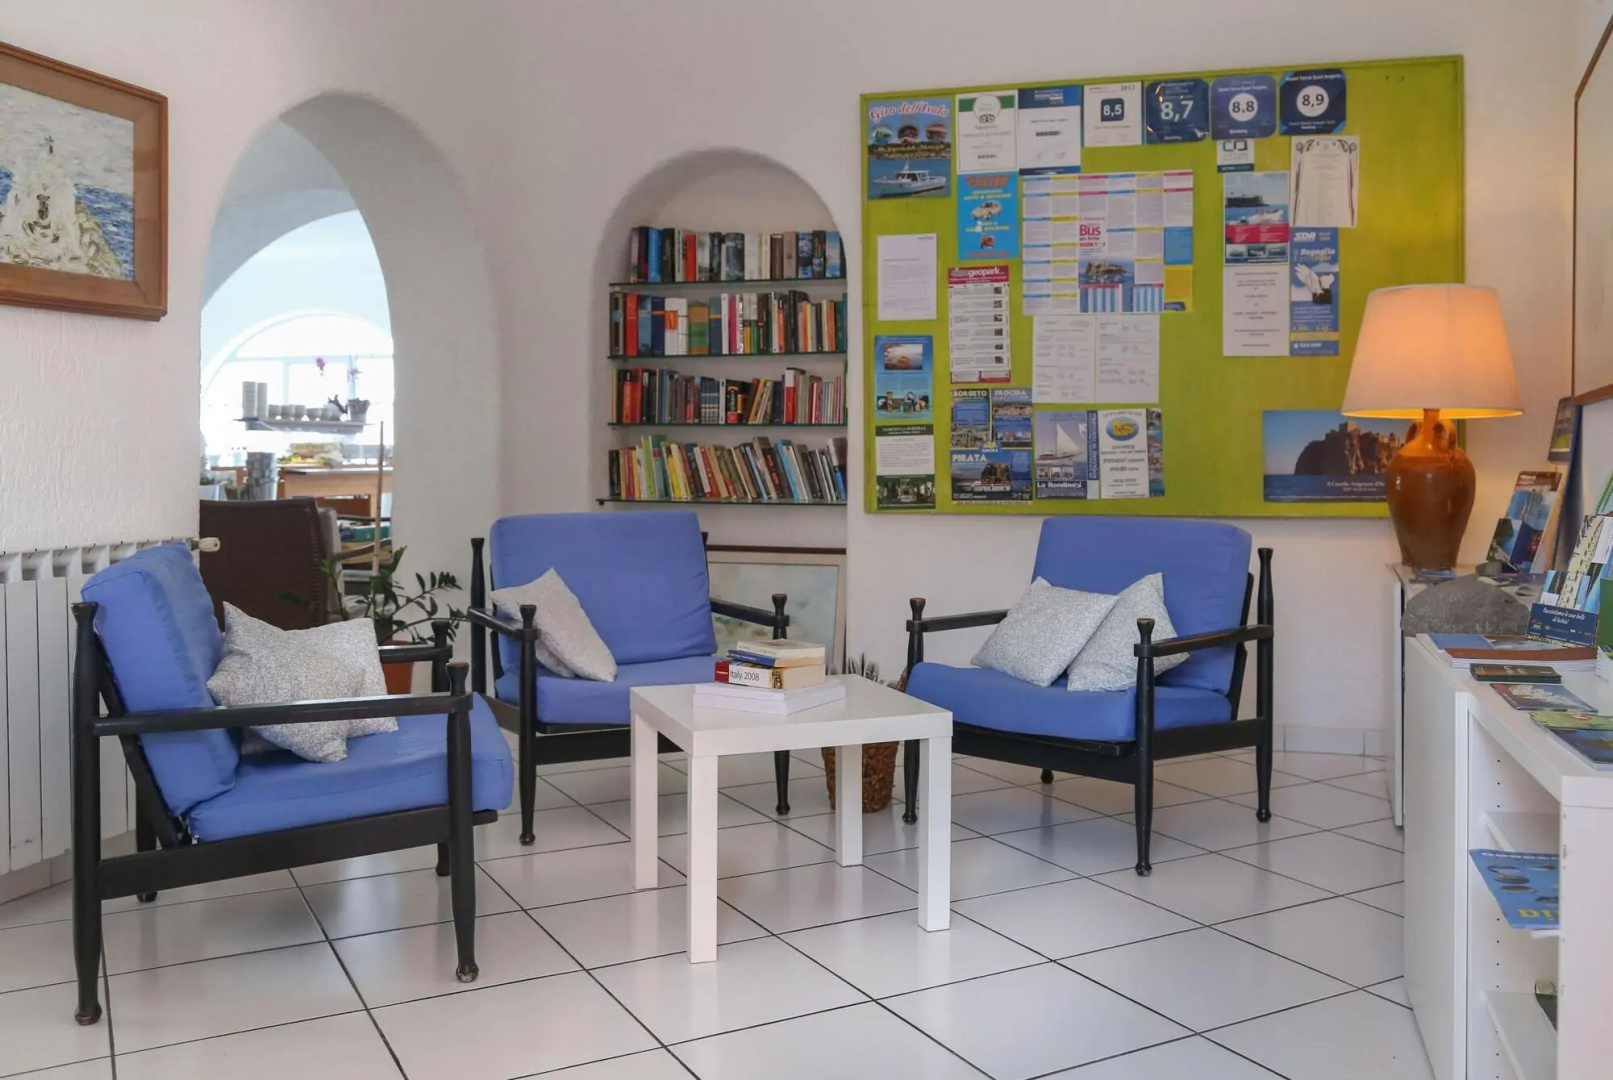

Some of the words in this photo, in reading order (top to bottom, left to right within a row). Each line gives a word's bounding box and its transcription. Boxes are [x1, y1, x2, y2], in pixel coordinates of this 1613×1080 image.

[1302, 93, 1325, 108] 8,9
[869, 105, 897, 123] Giro
[1103, 104, 1122, 117] 8,5
[1161, 100, 1194, 122] 8,7
[1079, 224, 1101, 236] Bus
[952, 453, 987, 462] PIRATA
[730, 669, 743, 681] Italy
[744, 671, 760, 681] 2008
